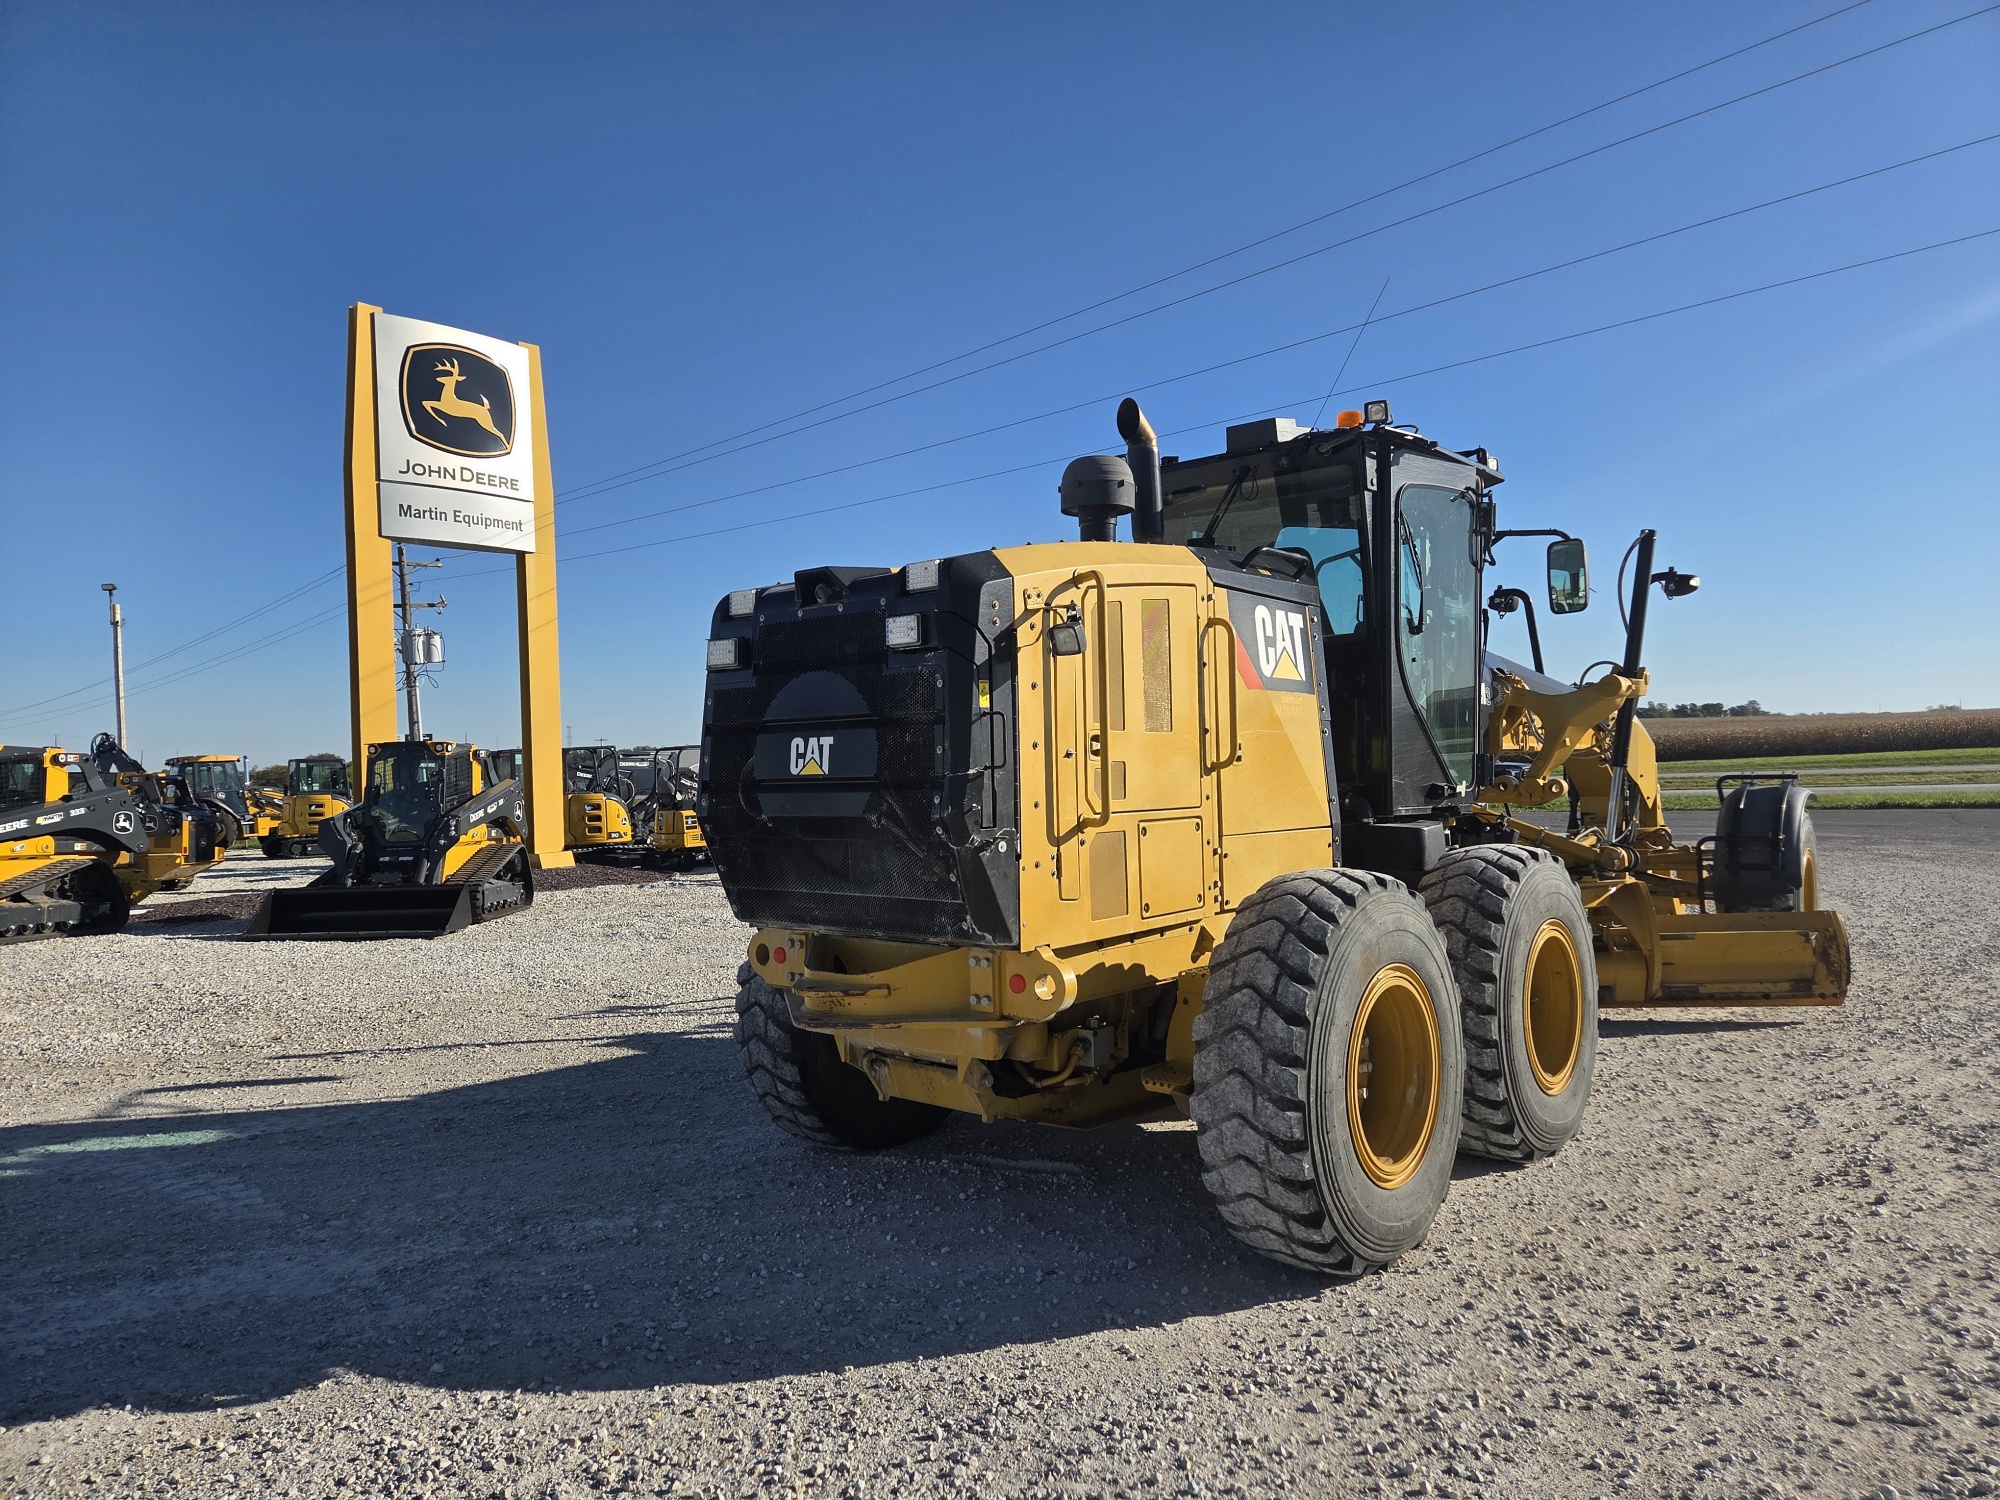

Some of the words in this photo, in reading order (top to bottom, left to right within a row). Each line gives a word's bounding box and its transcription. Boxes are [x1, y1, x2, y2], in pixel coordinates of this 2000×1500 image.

[398, 459, 456, 480] JOHN
[460, 466, 520, 491] DEERE
[398, 503, 448, 521] Martin
[453, 509, 524, 532] Equipment
[1254, 604, 1306, 681] CAT
[790, 736, 834, 775] CAT
[0, 819, 29, 833] EERE
